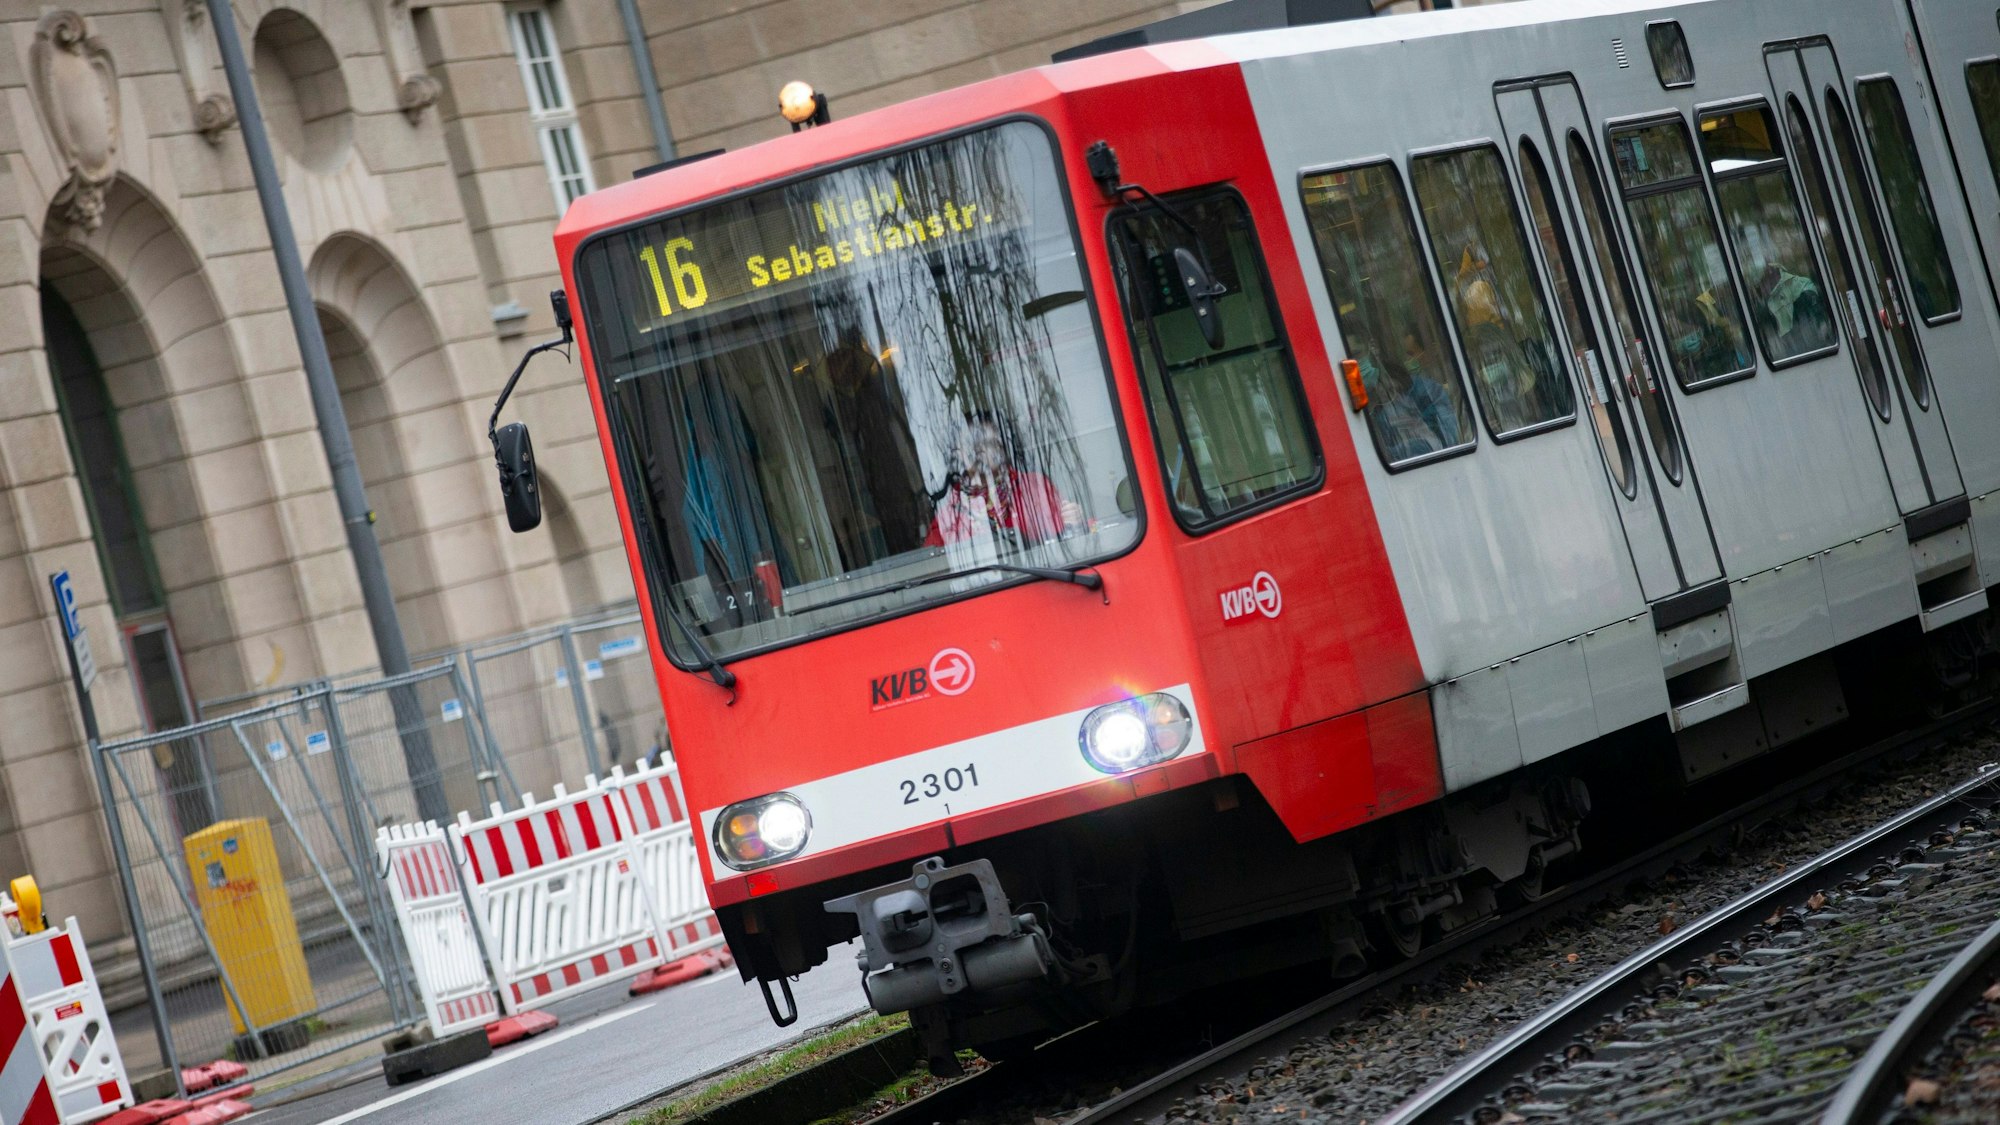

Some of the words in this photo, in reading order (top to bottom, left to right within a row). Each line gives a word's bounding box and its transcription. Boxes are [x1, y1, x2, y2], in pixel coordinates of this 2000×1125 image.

[813, 180, 905, 232] Niehl
[746, 201, 992, 287] Sebastianstr.
[640, 237, 708, 316] 16
[1220, 587, 1256, 620] KVB
[871, 668, 928, 705] KVB
[900, 763, 979, 805] 2301
